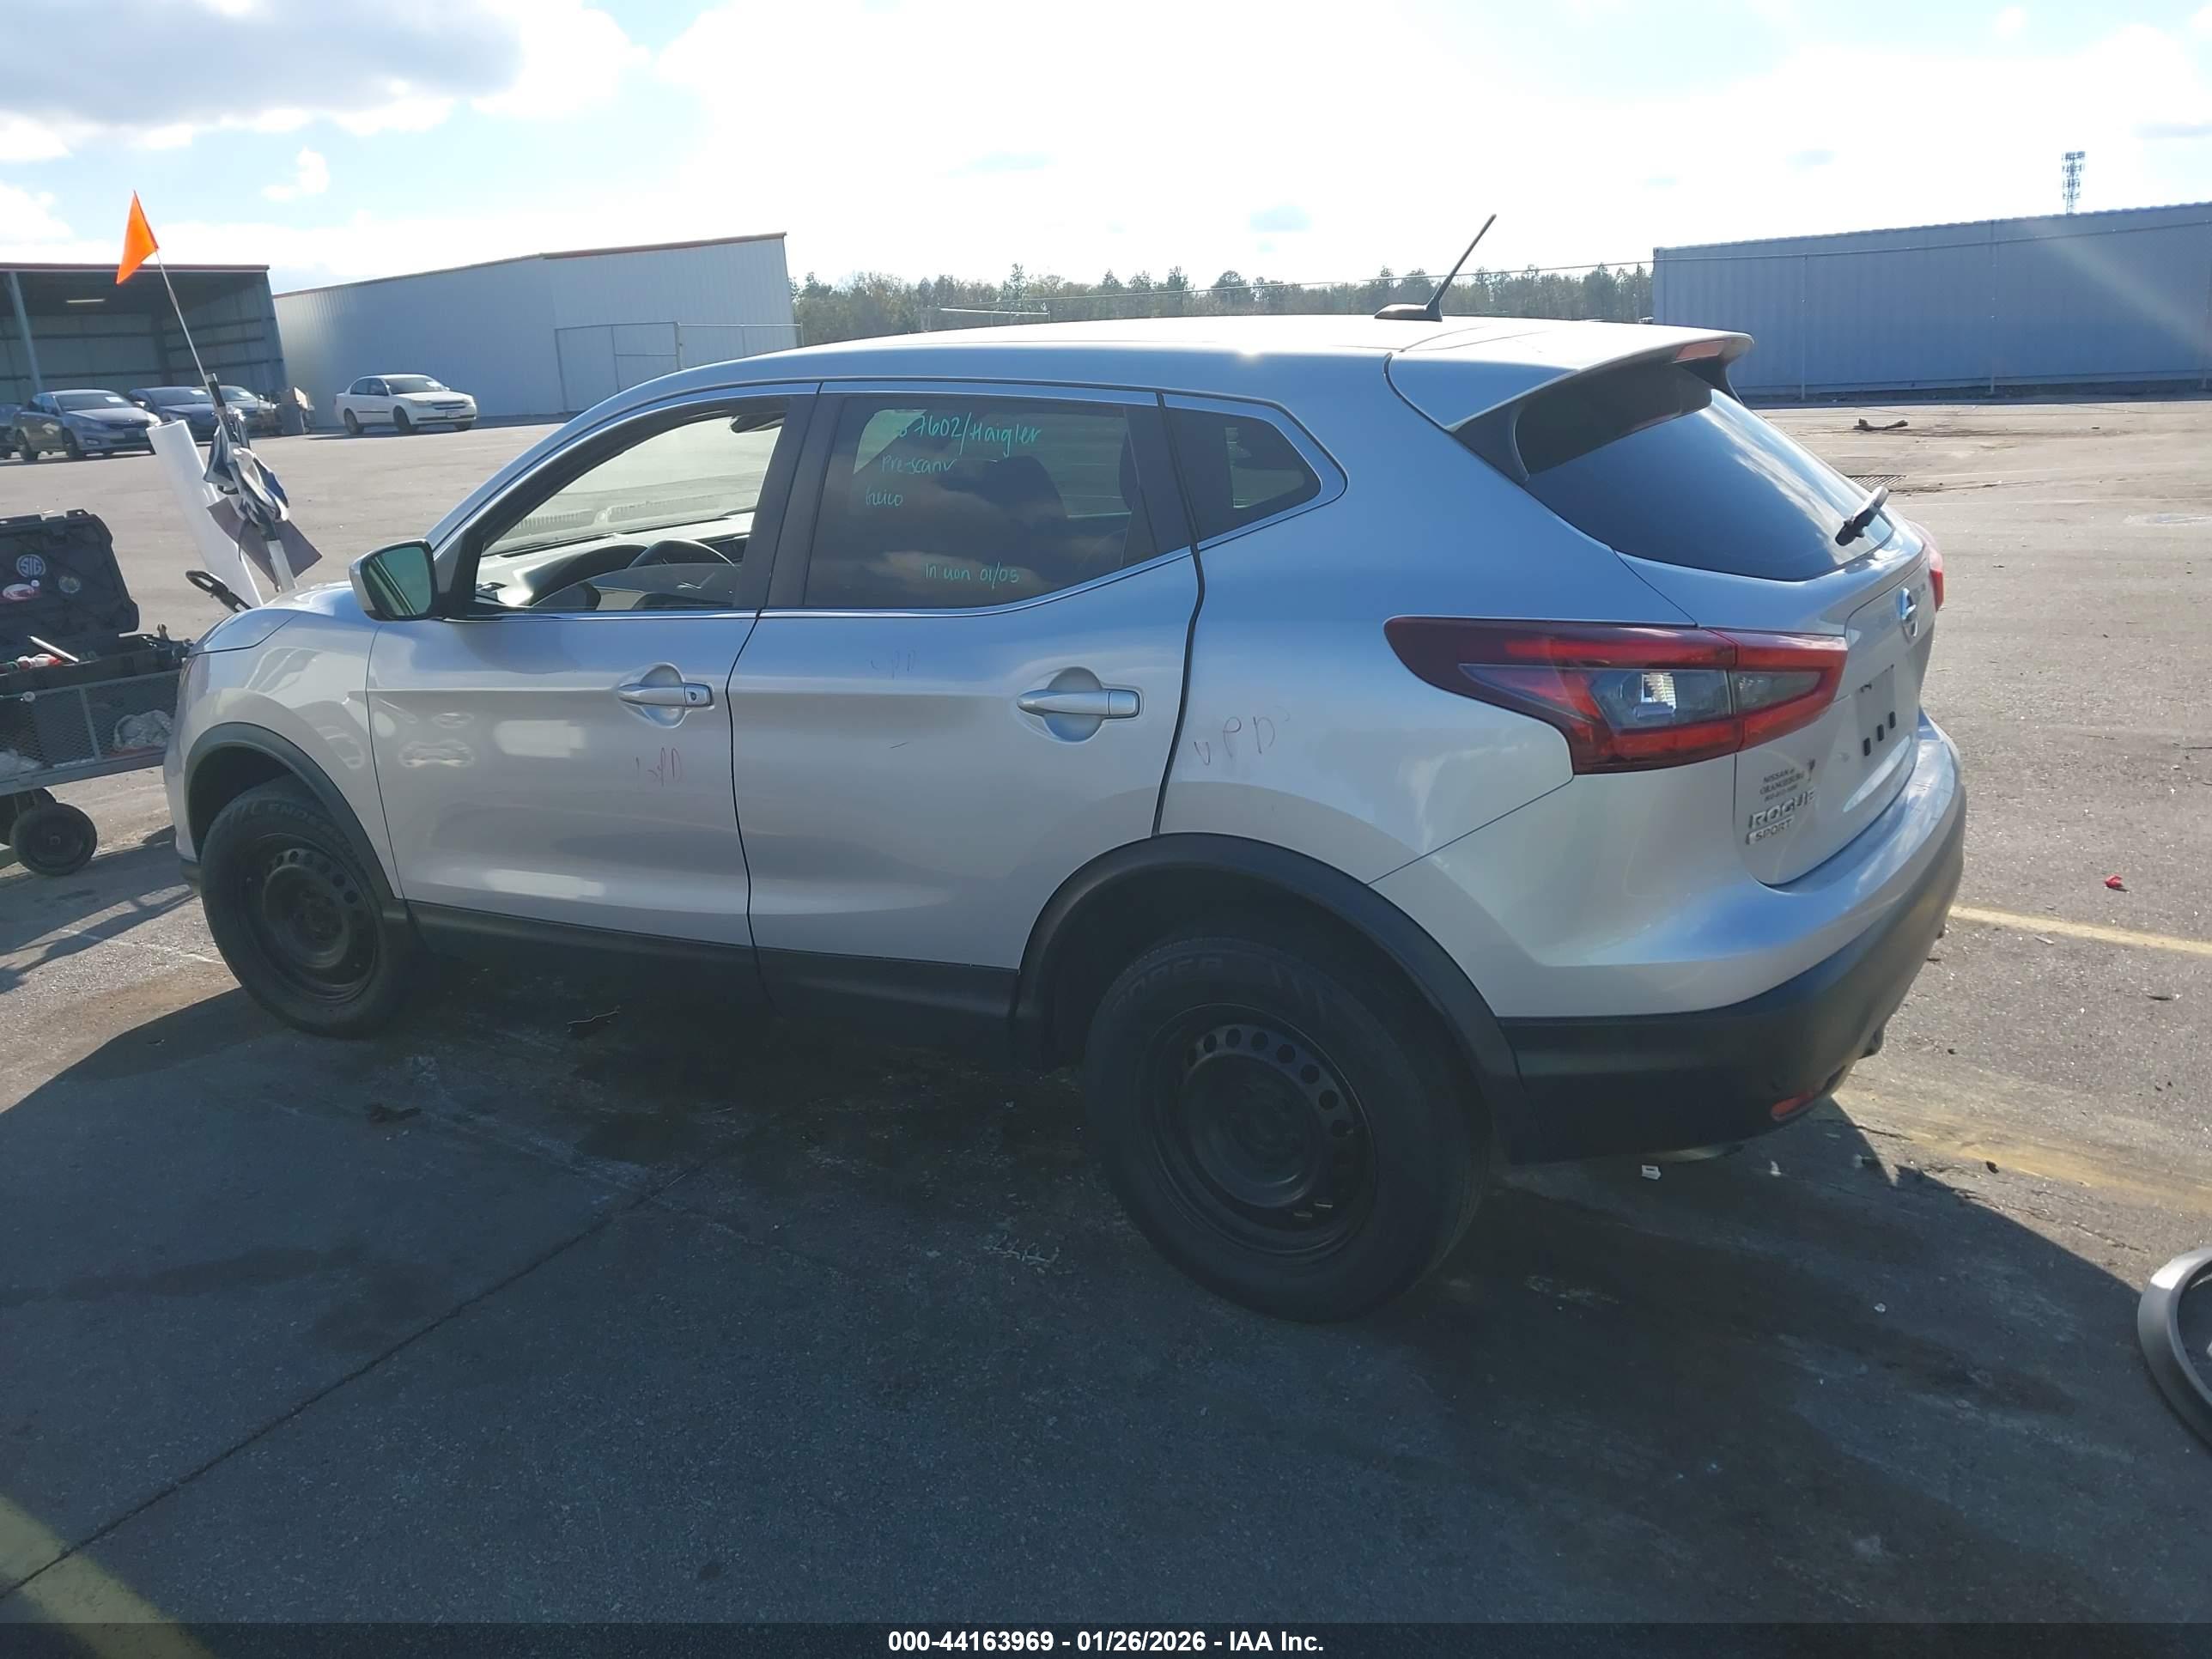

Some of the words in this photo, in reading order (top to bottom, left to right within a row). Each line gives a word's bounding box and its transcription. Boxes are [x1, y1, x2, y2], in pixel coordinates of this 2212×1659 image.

[20, 556, 43, 576] SIG
[1748, 789, 1814, 829] ROGUE
[1754, 817, 1793, 842] SPORT
